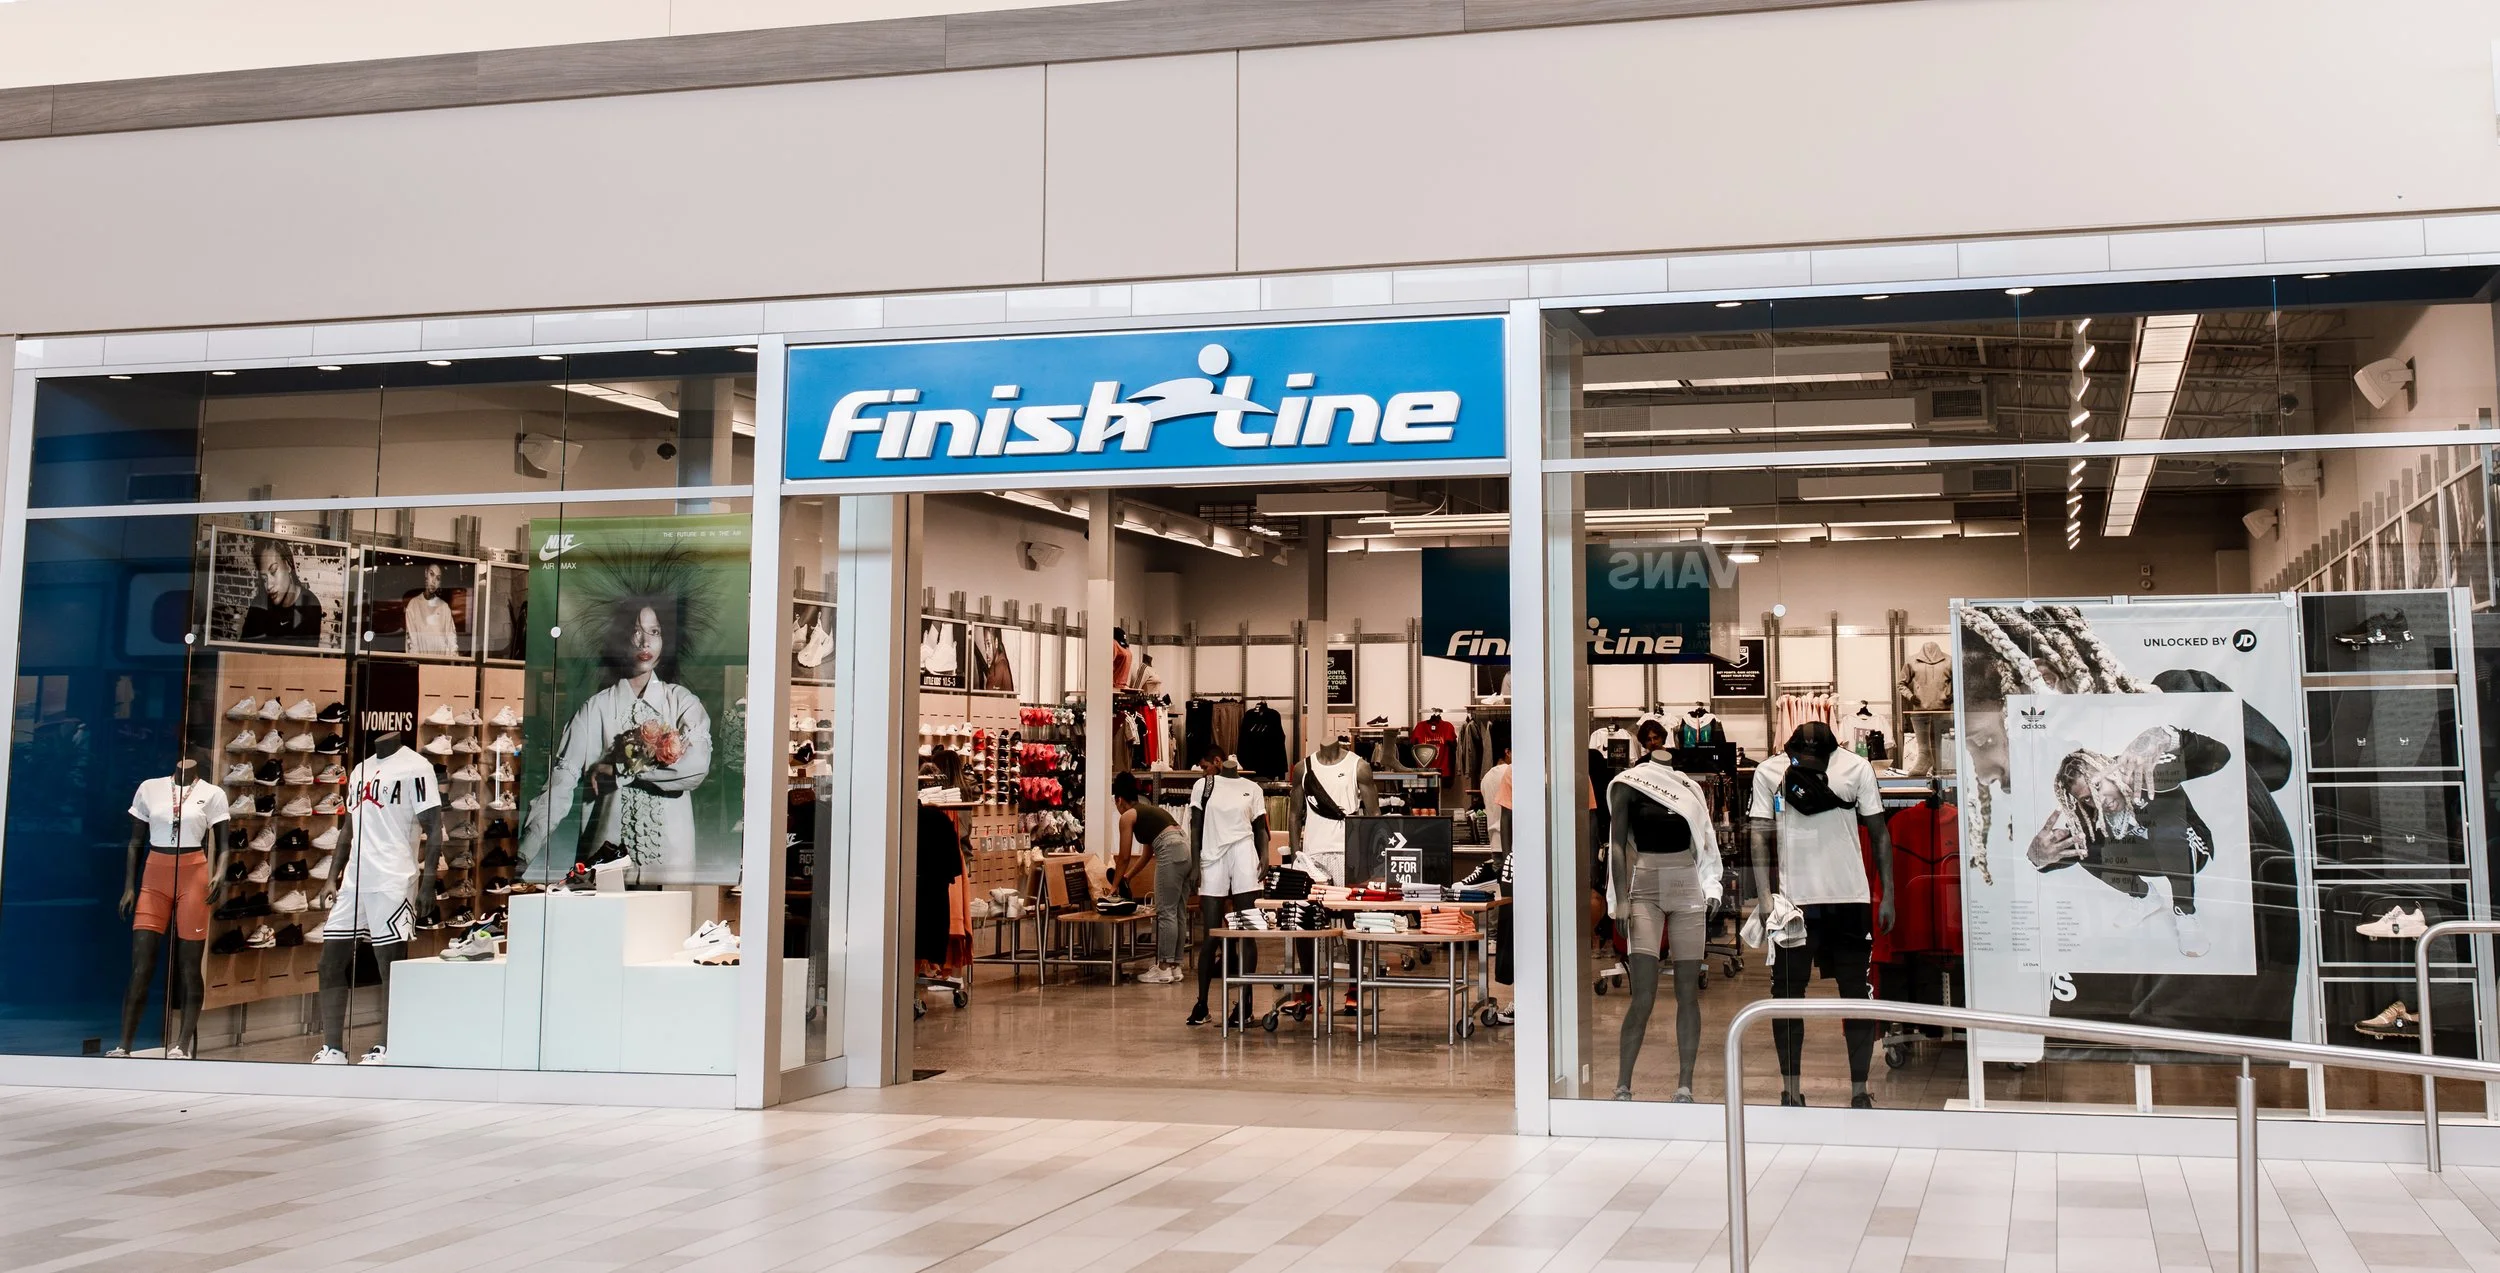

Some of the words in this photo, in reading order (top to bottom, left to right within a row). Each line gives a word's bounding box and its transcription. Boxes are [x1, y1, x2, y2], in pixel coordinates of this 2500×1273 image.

[545, 534, 575, 549] NIKE
[2143, 637, 2208, 647] UNLOCKED
[2212, 637, 2227, 646] BY
[361, 711, 413, 732] WOMEN'S
[1390, 861, 1398, 873] 2
[1399, 861, 1417, 873] FOR
[1395, 874, 1412, 884] $40
